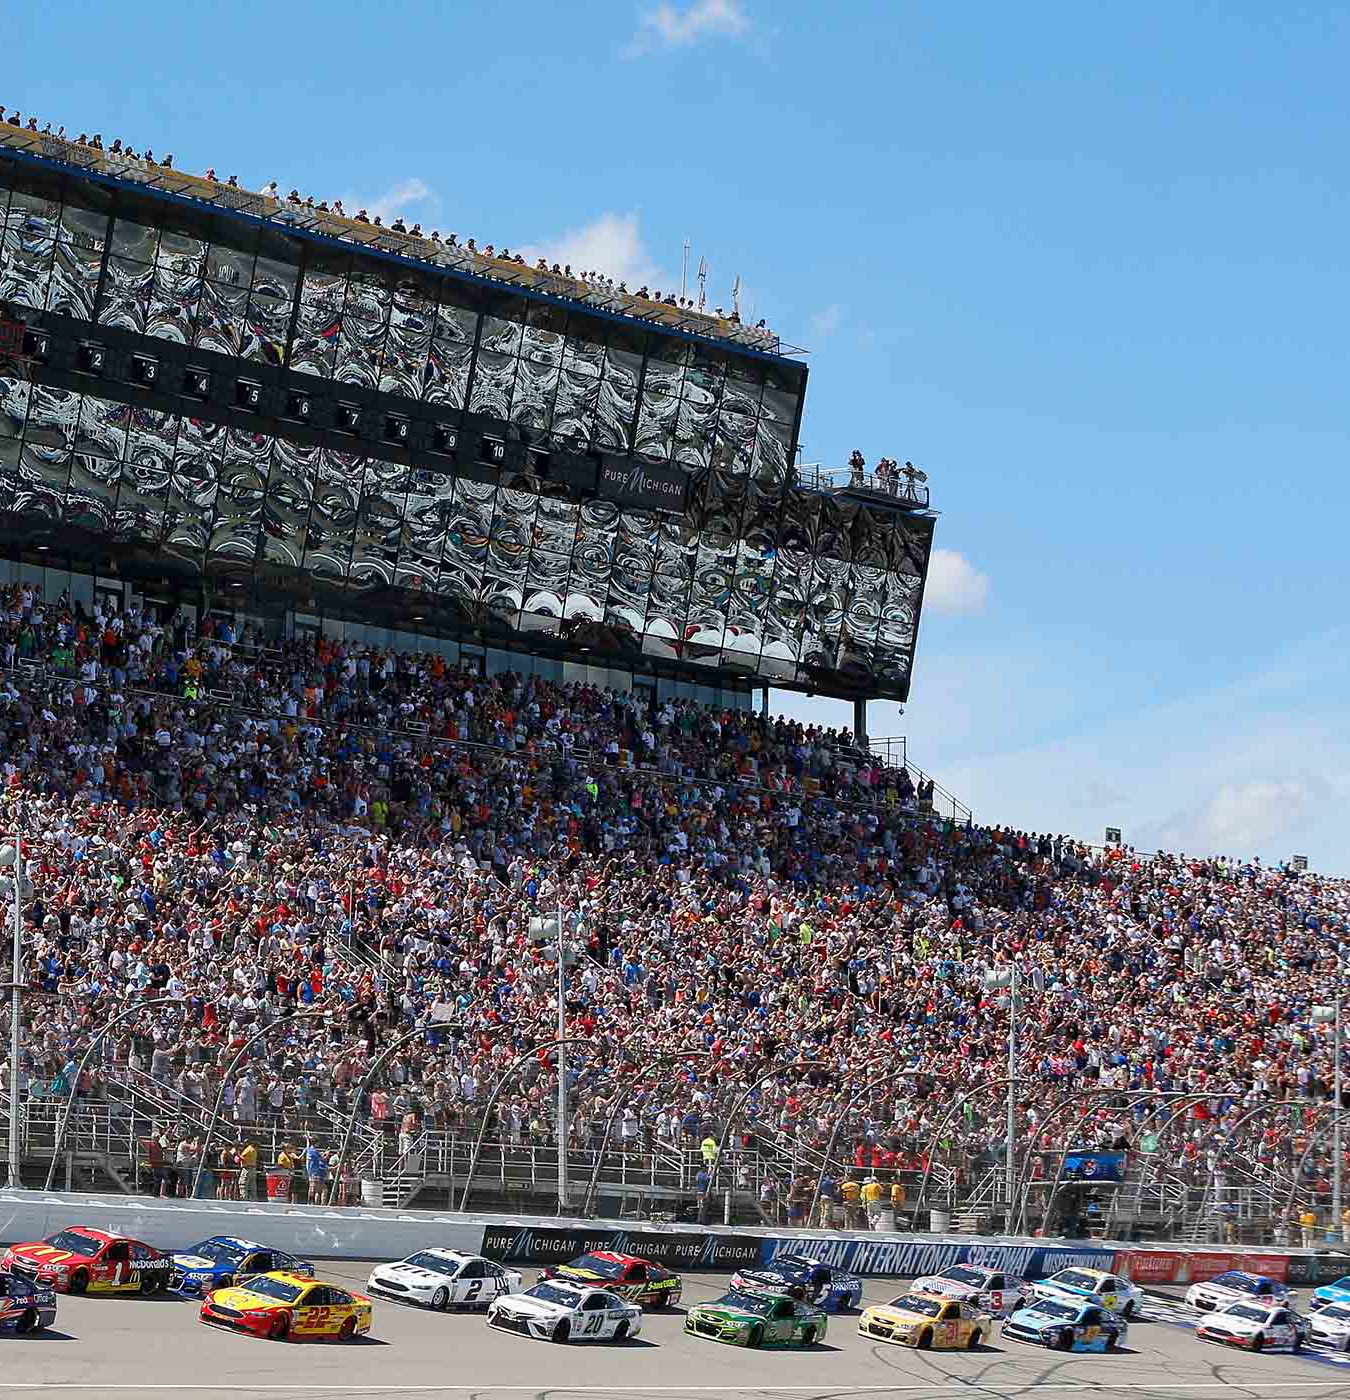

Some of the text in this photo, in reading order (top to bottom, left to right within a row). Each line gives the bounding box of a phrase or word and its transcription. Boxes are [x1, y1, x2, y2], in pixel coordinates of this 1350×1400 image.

[39, 340, 47, 353] 1
[93, 353, 102, 367] 2
[147, 366, 156, 378] 3
[199, 378, 208, 392] 4
[250, 390, 259, 403] 5
[301, 402, 310, 415] 6
[350, 412, 359, 425] 7
[399, 424, 407, 437] 8
[448, 434, 456, 447] 9
[492, 445, 504, 458] 10
[604, 464, 682, 496] PURE MICHIGAN
[486, 1228, 757, 1264] PURE MICHIGAN PURE MICHIGAN PURE MICHIGAN
[129, 1258, 169, 1270] McDonald's
[771, 1240, 1035, 1276] MICHIGAN INTERNATIONAL SPEEDWAY
[111, 1261, 123, 1286] 1
[464, 1279, 483, 1301] 2
[304, 1306, 331, 1328] 22
[584, 1312, 604, 1334] 20
